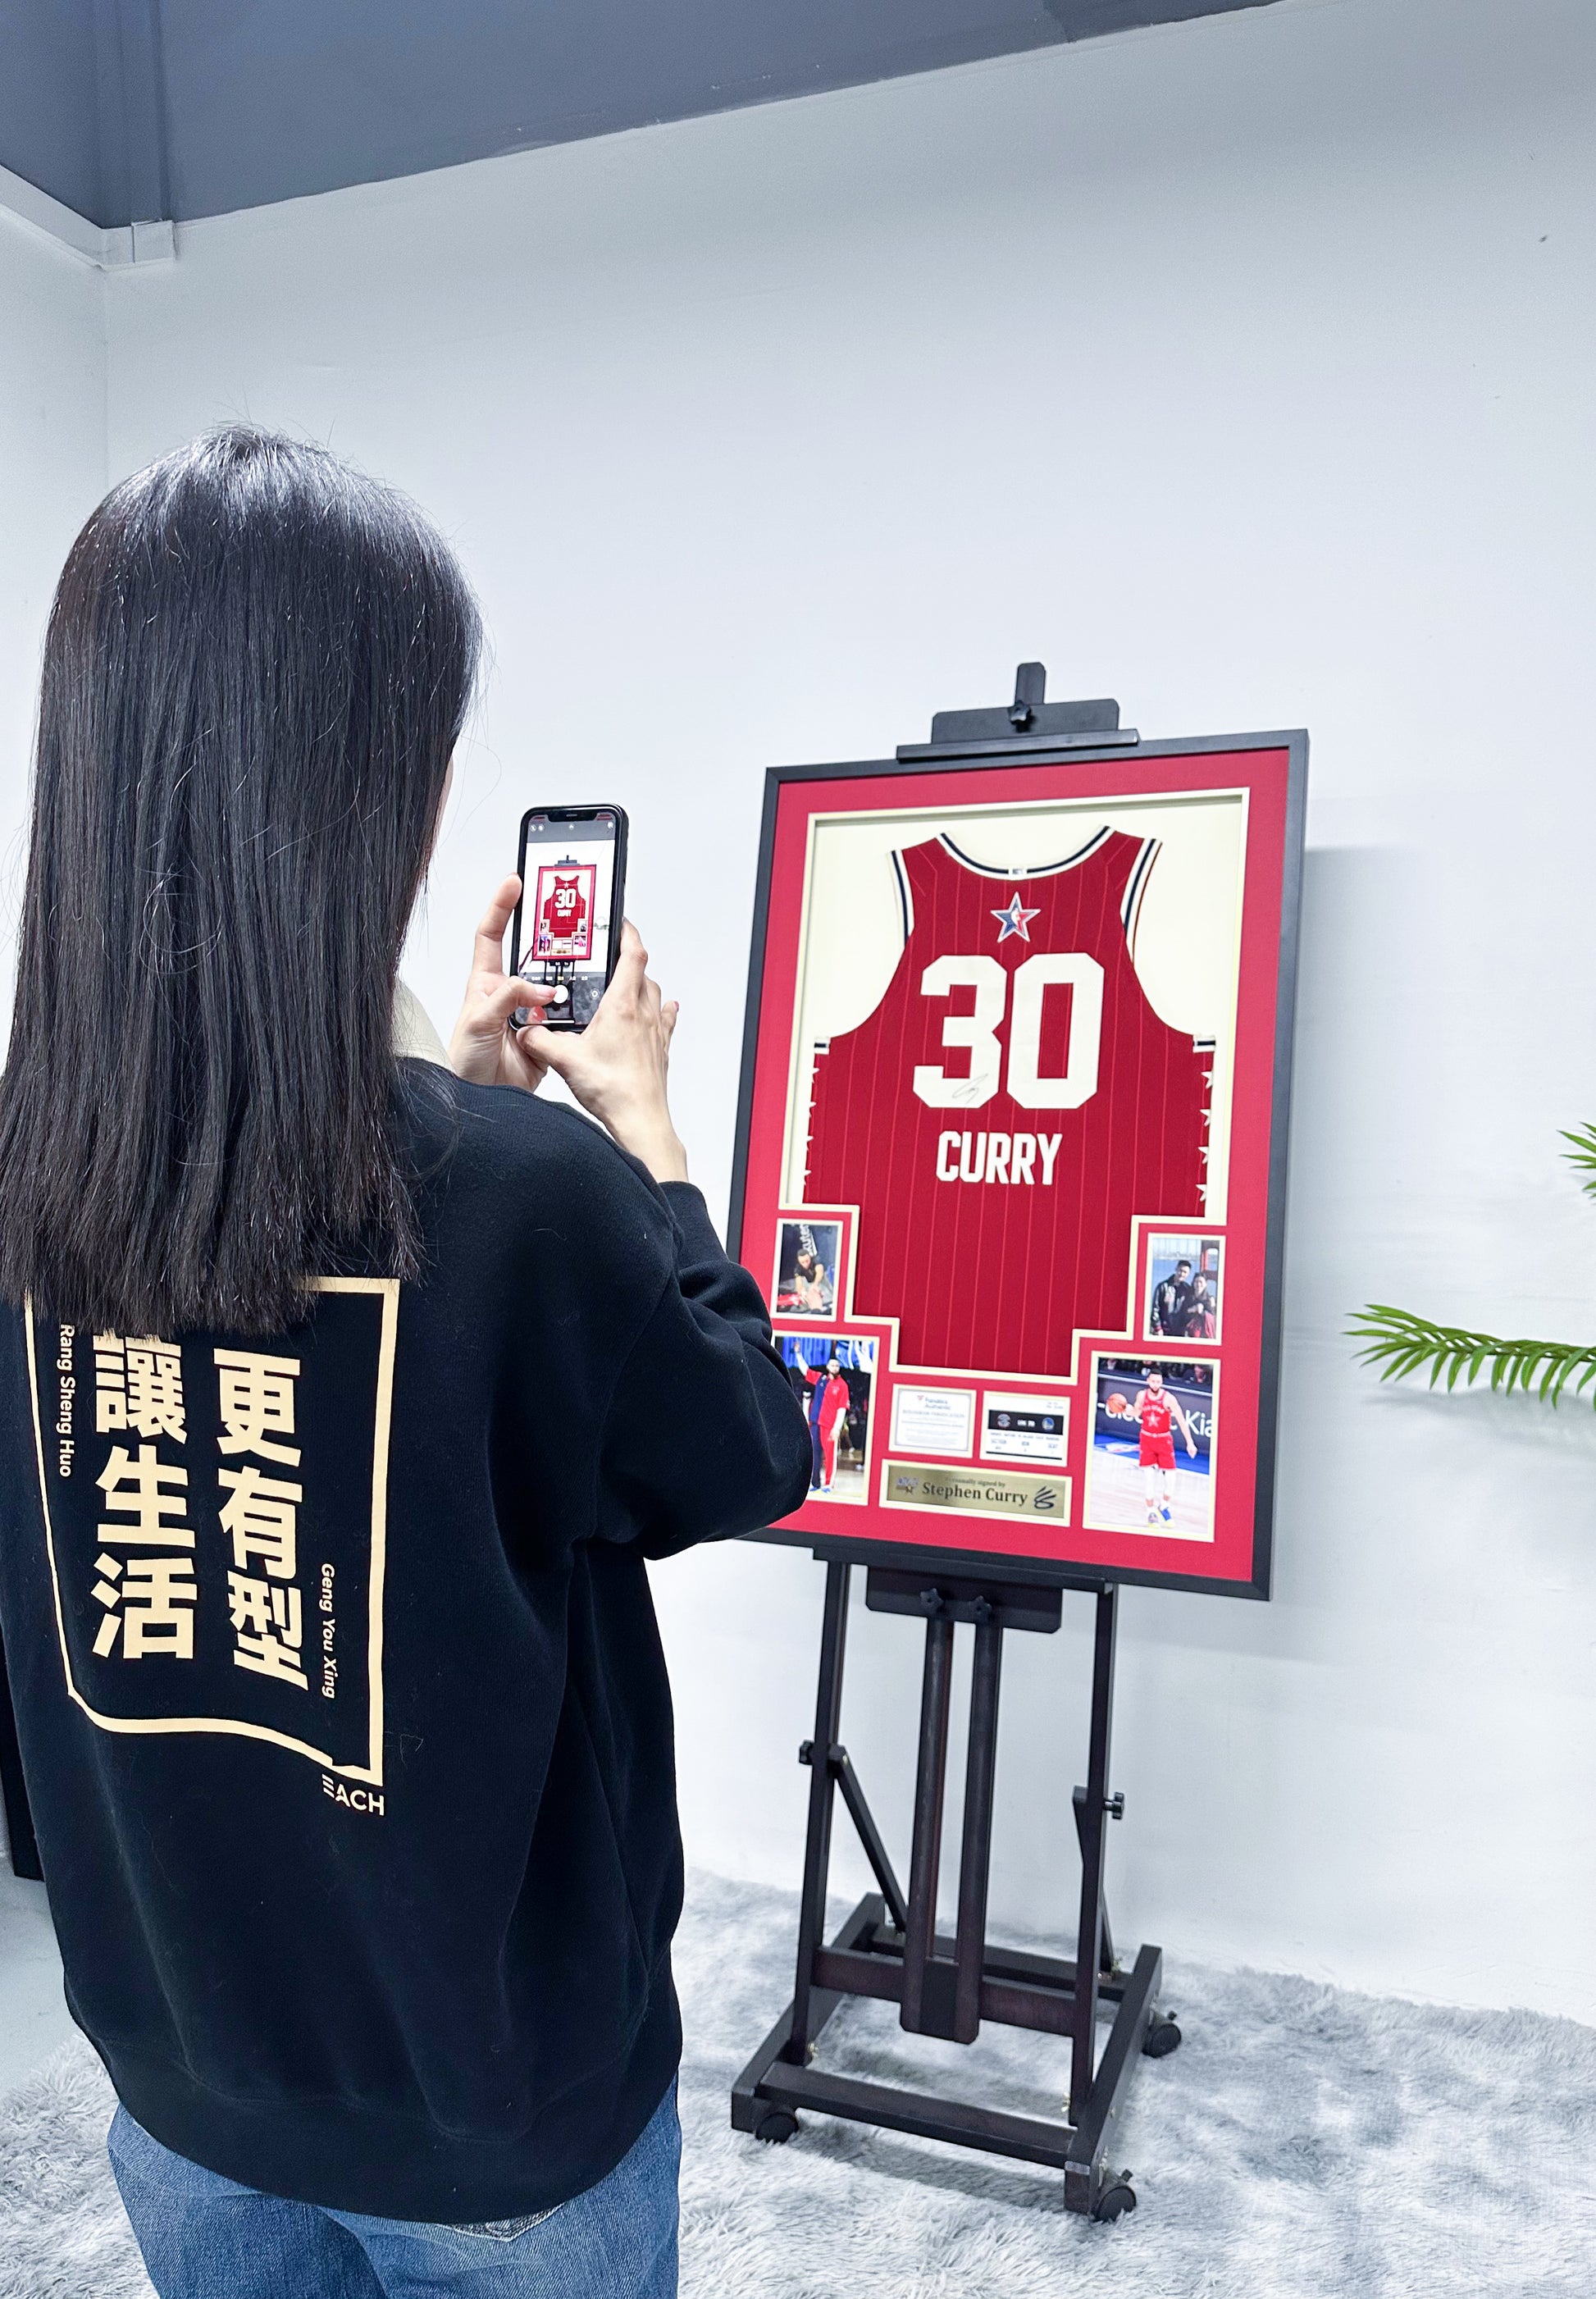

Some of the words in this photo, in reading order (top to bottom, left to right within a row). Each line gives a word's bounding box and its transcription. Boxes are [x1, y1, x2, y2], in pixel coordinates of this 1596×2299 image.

[555, 888, 577, 909] 30
[912, 951, 1105, 1110] 30
[936, 1130, 1063, 1186] CURRY
[57, 1324, 75, 1371] Rang
[56, 1375, 76, 1435] Sheng
[59, 1439, 75, 1477] Huo
[91, 1328, 198, 1659] 讓生活
[922, 1482, 981, 1500] Stephen
[985, 1487, 1028, 1507] Curry
[213, 1348, 309, 1691] 更有型
[319, 1563, 335, 1612] Geng
[322, 1618, 335, 1652] You
[321, 1655, 339, 1699] Xing
